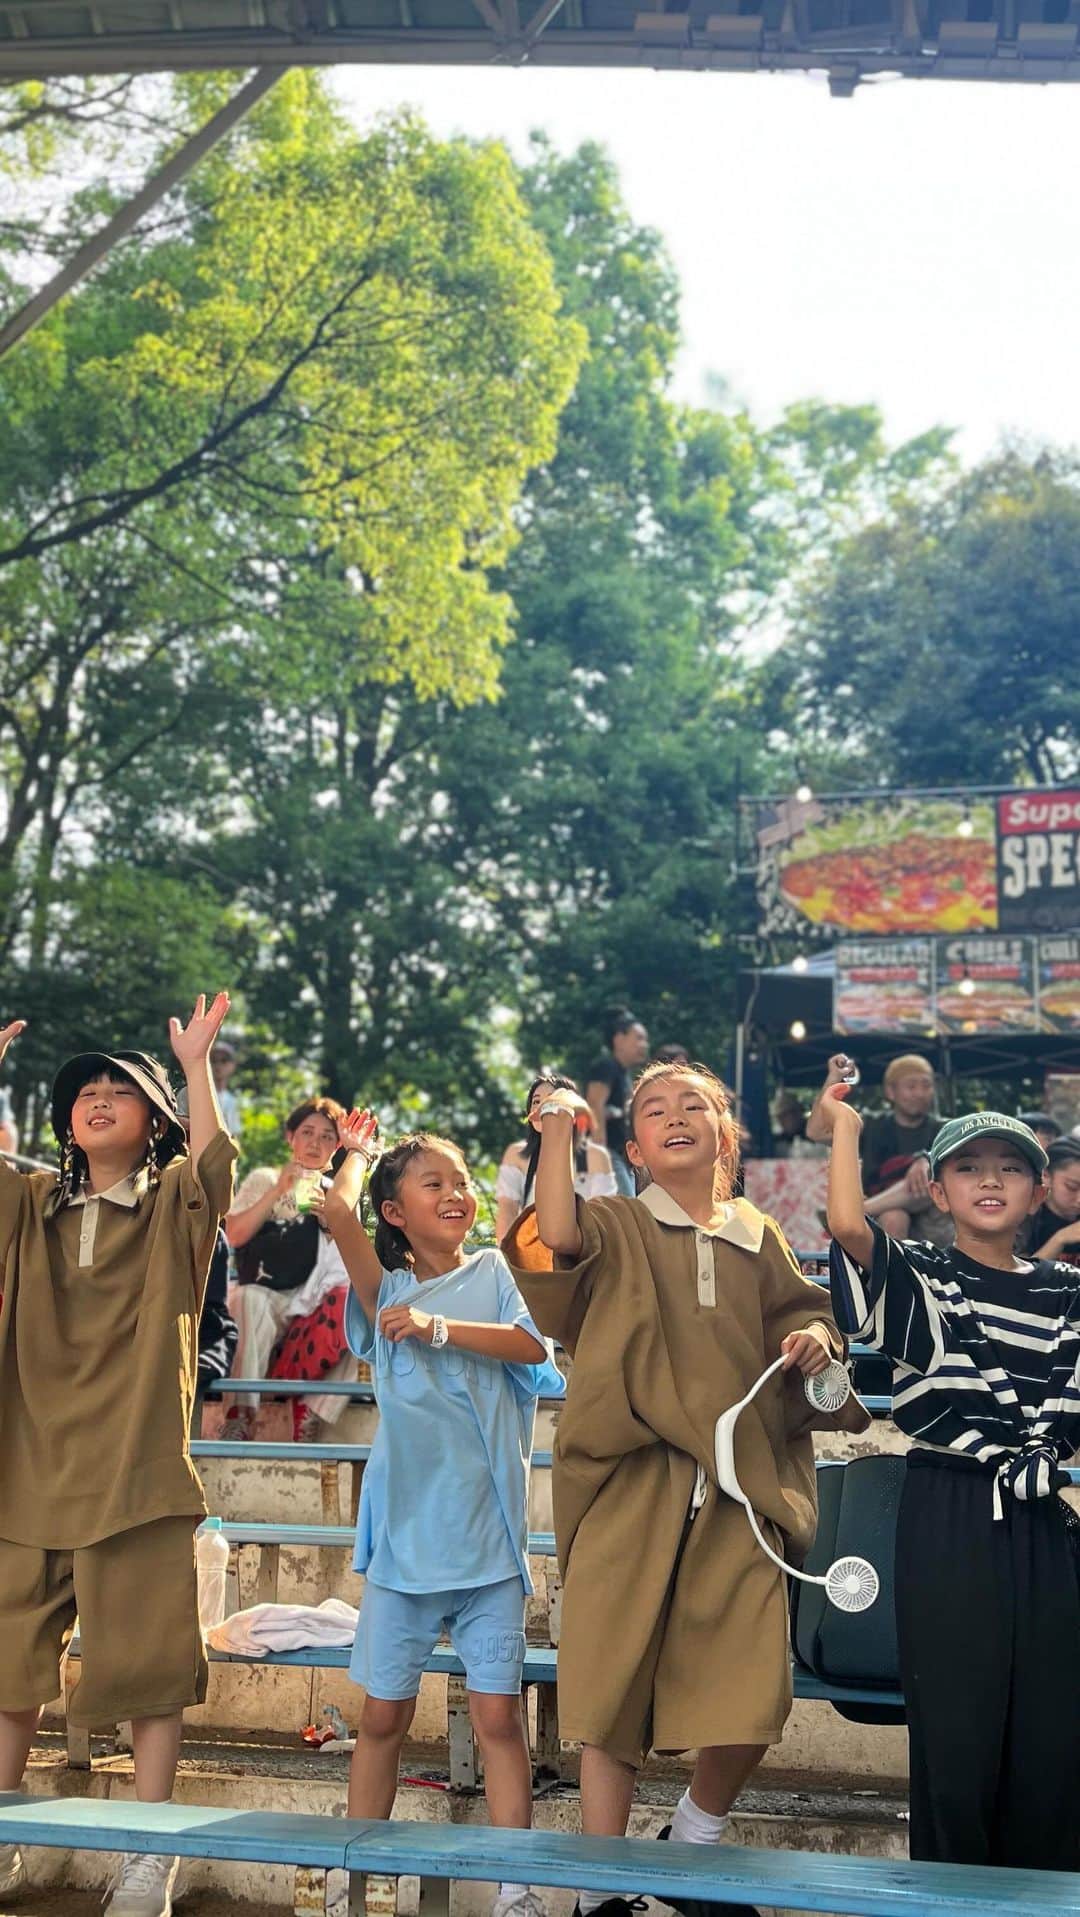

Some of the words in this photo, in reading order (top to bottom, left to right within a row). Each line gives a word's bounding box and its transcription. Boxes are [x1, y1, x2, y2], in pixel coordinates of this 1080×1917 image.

[1002, 833, 1080, 898] SPE
[946, 940, 1023, 962] CHILI
[961, 1120, 975, 1134] LOS
